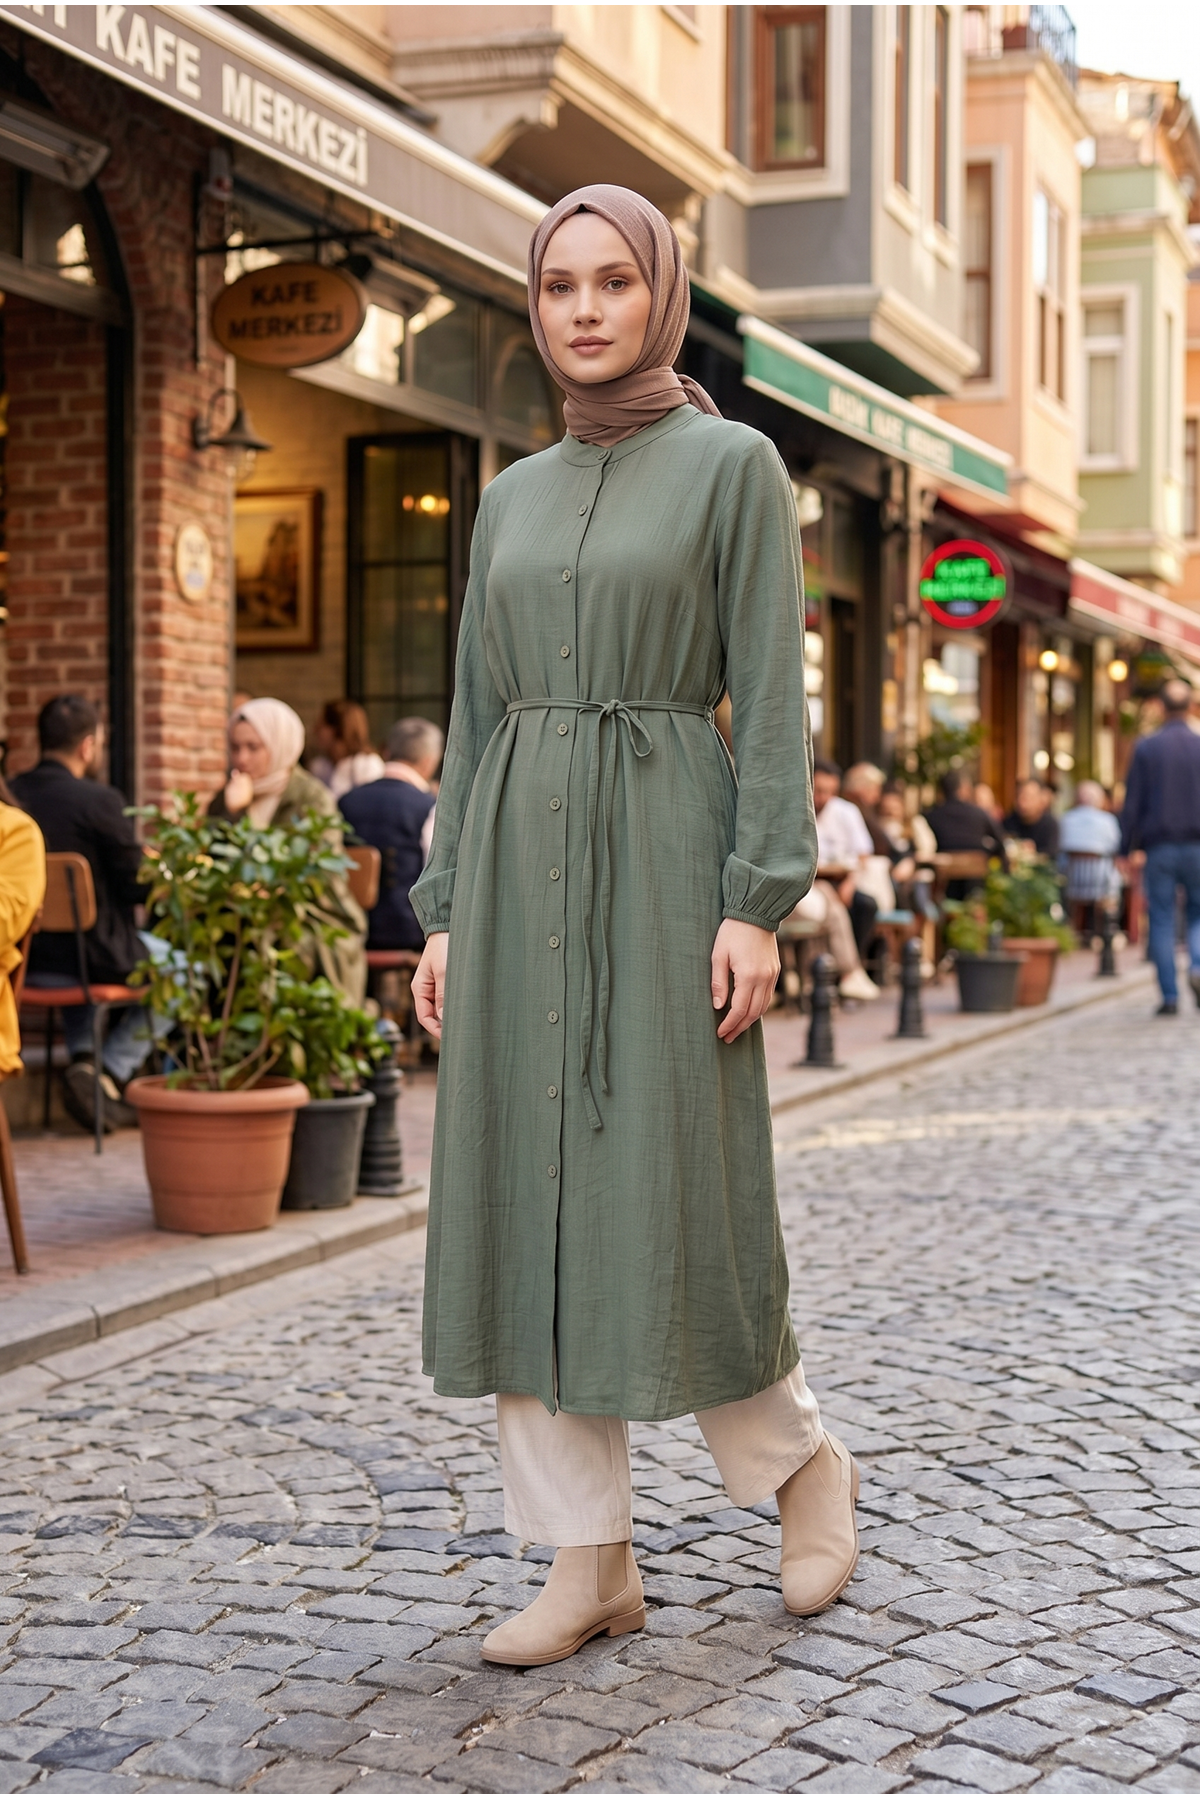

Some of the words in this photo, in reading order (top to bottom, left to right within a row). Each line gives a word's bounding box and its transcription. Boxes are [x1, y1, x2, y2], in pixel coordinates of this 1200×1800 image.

[96, 5, 201, 101] KAFE
[221, 62, 368, 187] MERKEZİ
[252, 280, 317, 305] KAFE
[229, 306, 342, 339] MERKEZİ
